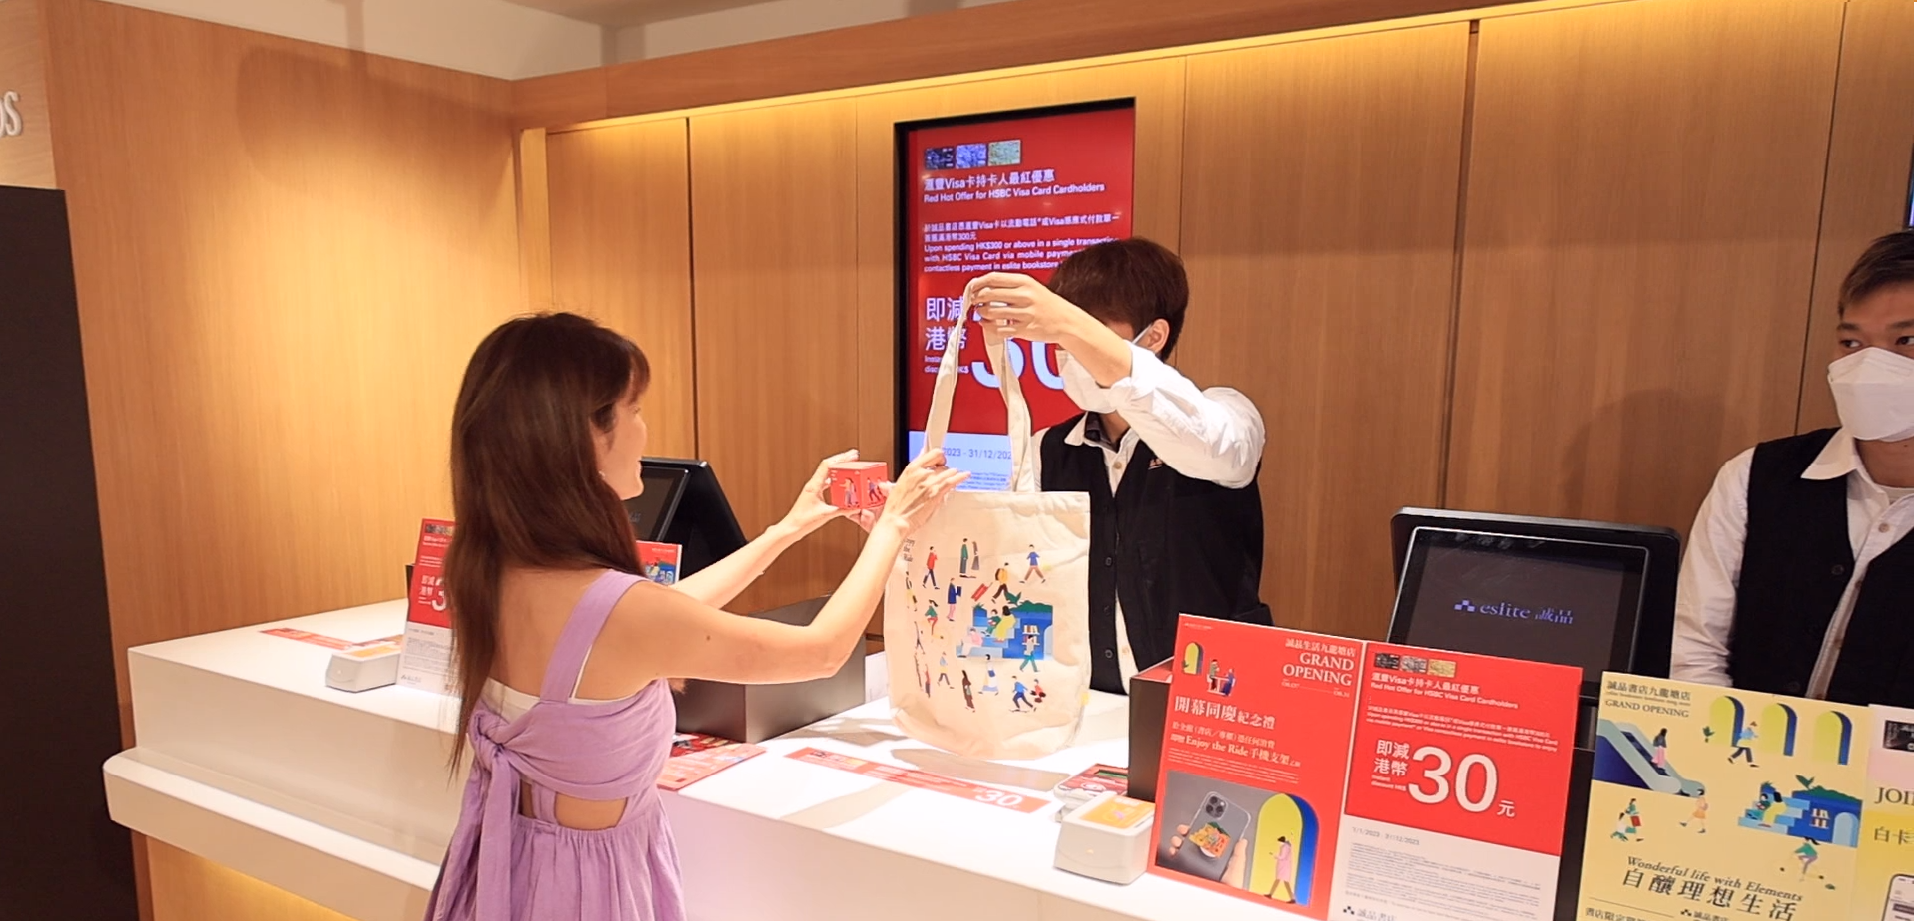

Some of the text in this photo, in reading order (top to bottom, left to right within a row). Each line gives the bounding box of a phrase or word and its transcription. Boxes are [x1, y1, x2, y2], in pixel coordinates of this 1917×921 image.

[924, 182, 1105, 203] Red Hot Offer for HSBC Visa Card Cardholders
[924, 245, 943, 253] Upon
[944, 243, 975, 252] spending
[1013, 240, 1036, 248] above
[1037, 239, 1045, 247] in
[1052, 238, 1075, 248] single
[924, 254, 940, 262] with
[964, 252, 980, 261] Visa
[982, 252, 1001, 260] Card
[1003, 251, 1015, 259] via
[1017, 250, 1044, 259] mobile
[961, 263, 992, 273] payment
[993, 262, 1001, 270] in
[968, 448, 1011, 460] 31/12/202
[1480, 602, 1531, 619] eslite
[1300, 652, 1355, 671] GRAND
[1283, 664, 1353, 686] OPENING
[1371, 682, 1384, 690] Red
[1384, 684, 1396, 692] Hot
[1396, 686, 1413, 694] Offer
[1424, 690, 1444, 699] HSBC
[1459, 695, 1476, 703] Card
[1477, 697, 1519, 709] Cardholders
[1174, 696, 1276, 729] 開幕同慶紀念禮
[1605, 699, 1689, 718] GRAND OPENING
[1186, 735, 1211, 751] Enjoy
[1212, 741, 1227, 752] the
[1228, 744, 1249, 757] Ride
[1377, 739, 1410, 760] 即減
[1373, 757, 1408, 776] 港幣
[1408, 745, 1515, 817] 30 元
[1628, 856, 1803, 901] Wonderful life with Elements
[1623, 868, 1798, 921] 自釀理想生活
